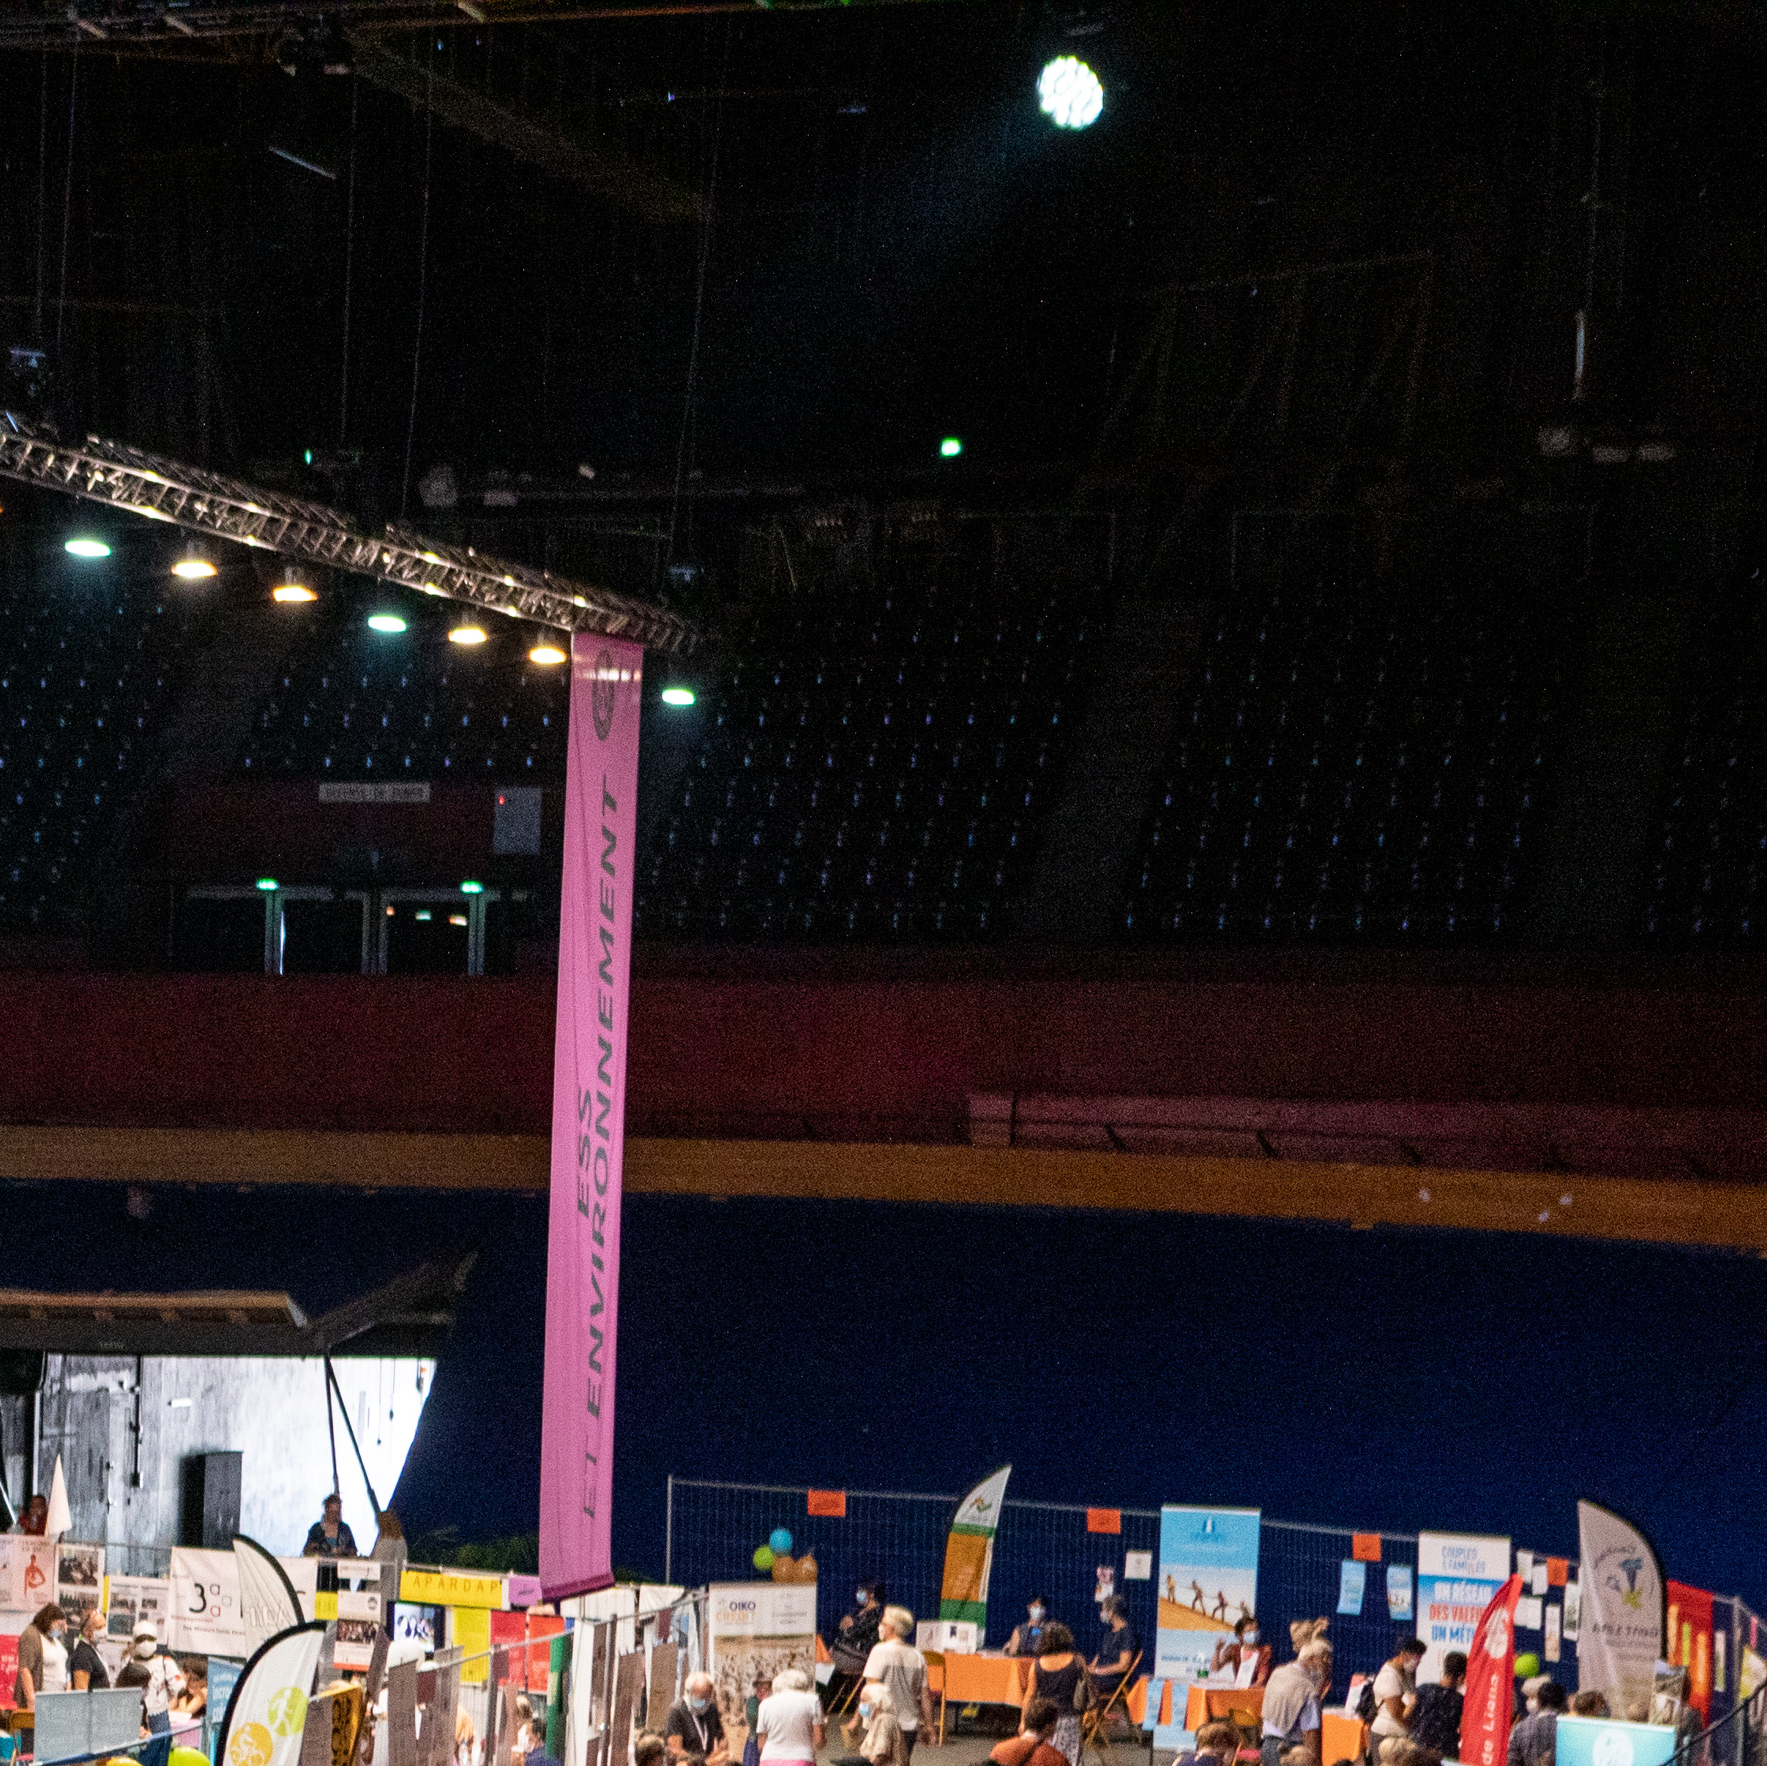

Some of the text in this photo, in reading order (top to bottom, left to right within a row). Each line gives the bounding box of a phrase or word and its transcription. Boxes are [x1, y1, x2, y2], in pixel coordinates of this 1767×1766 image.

[583, 771, 617, 1420] ENVIRONNEMENT
[576, 1087, 592, 1218] ESS
[412, 1574, 500, 1594] APARDAP
[729, 1601, 756, 1611] OIKO
[1483, 1671, 1499, 1735] Liens
